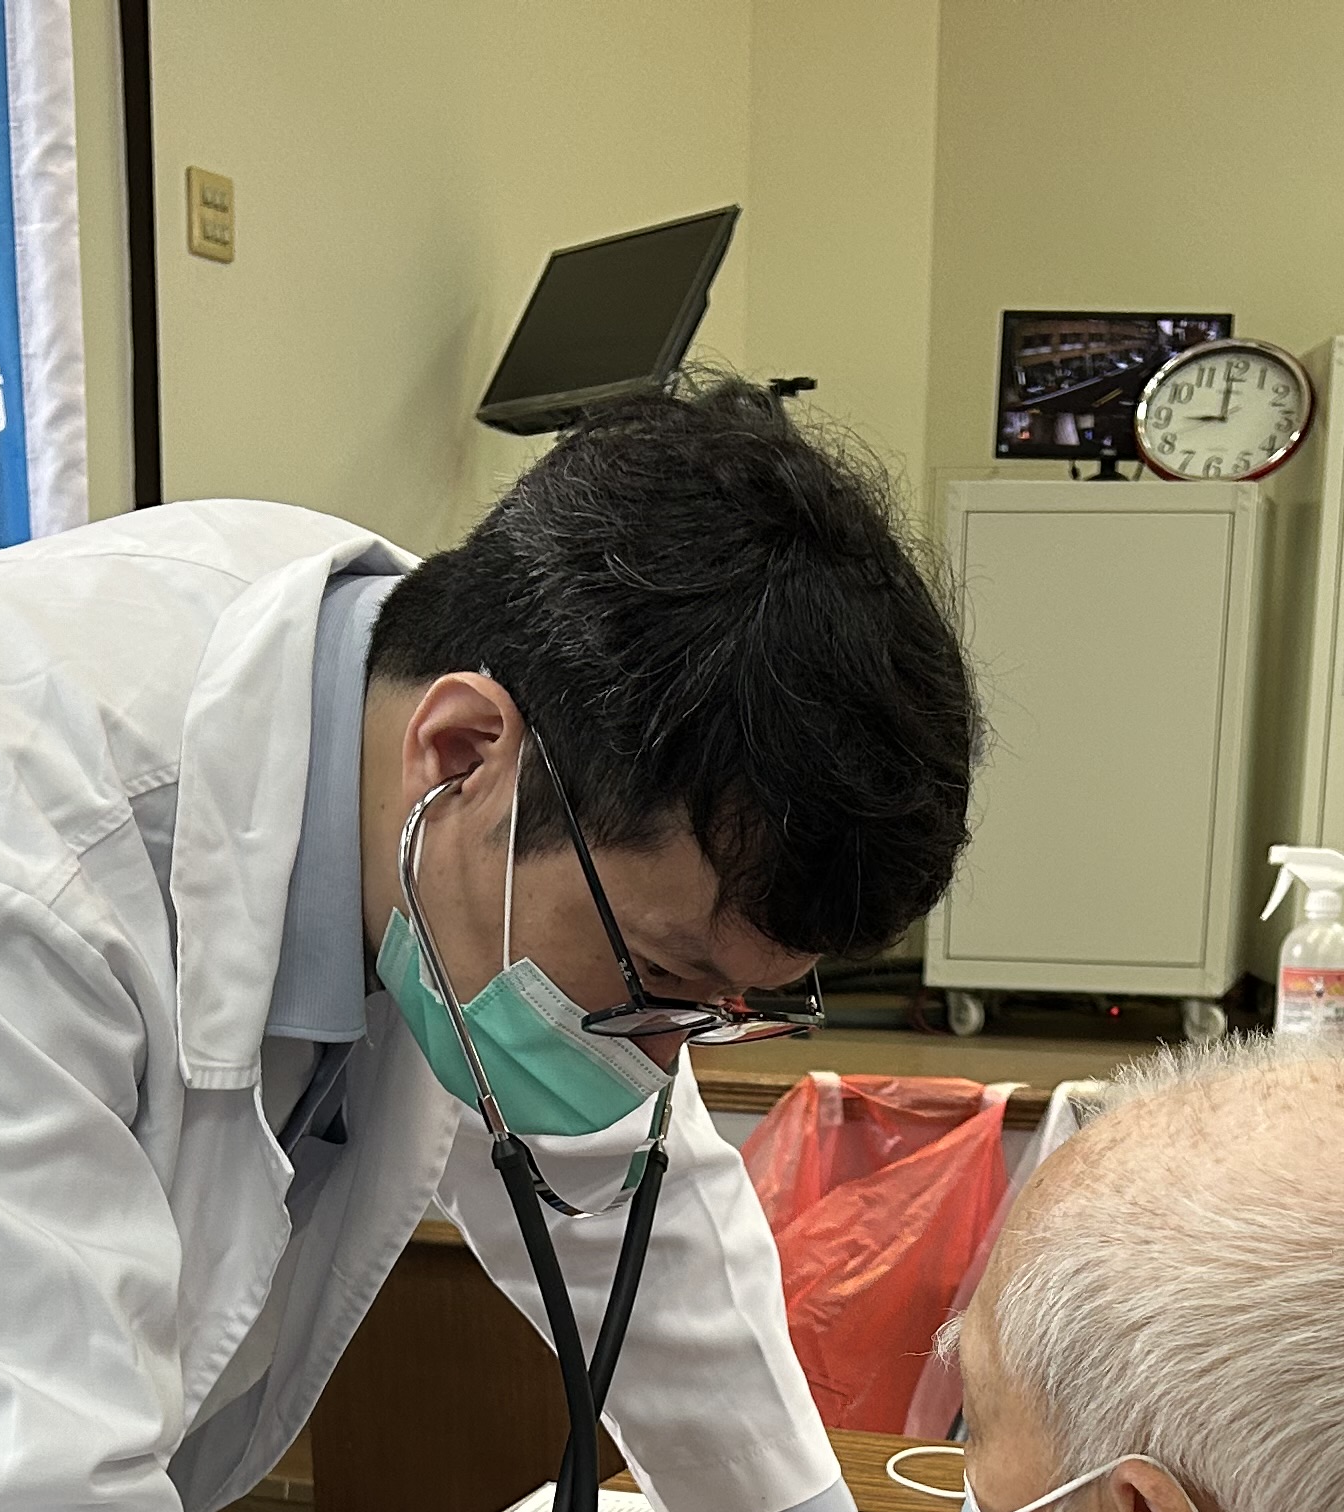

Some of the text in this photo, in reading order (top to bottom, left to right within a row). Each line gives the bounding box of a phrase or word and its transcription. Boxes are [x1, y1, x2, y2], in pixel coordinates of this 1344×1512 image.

[1195, 365, 1216, 388] 11
[1256, 368, 1267, 390] 1
[1168, 382, 1195, 404] 10
[1271, 385, 1290, 407] 2
[1152, 406, 1173, 430] 9
[1275, 408, 1295, 433] 3
[1158, 432, 1177, 455] 8
[1258, 435, 1277, 454] 4
[1178, 451, 1196, 472] 7
[1202, 455, 1223, 478] 6
[1233, 452, 1253, 473] 5
